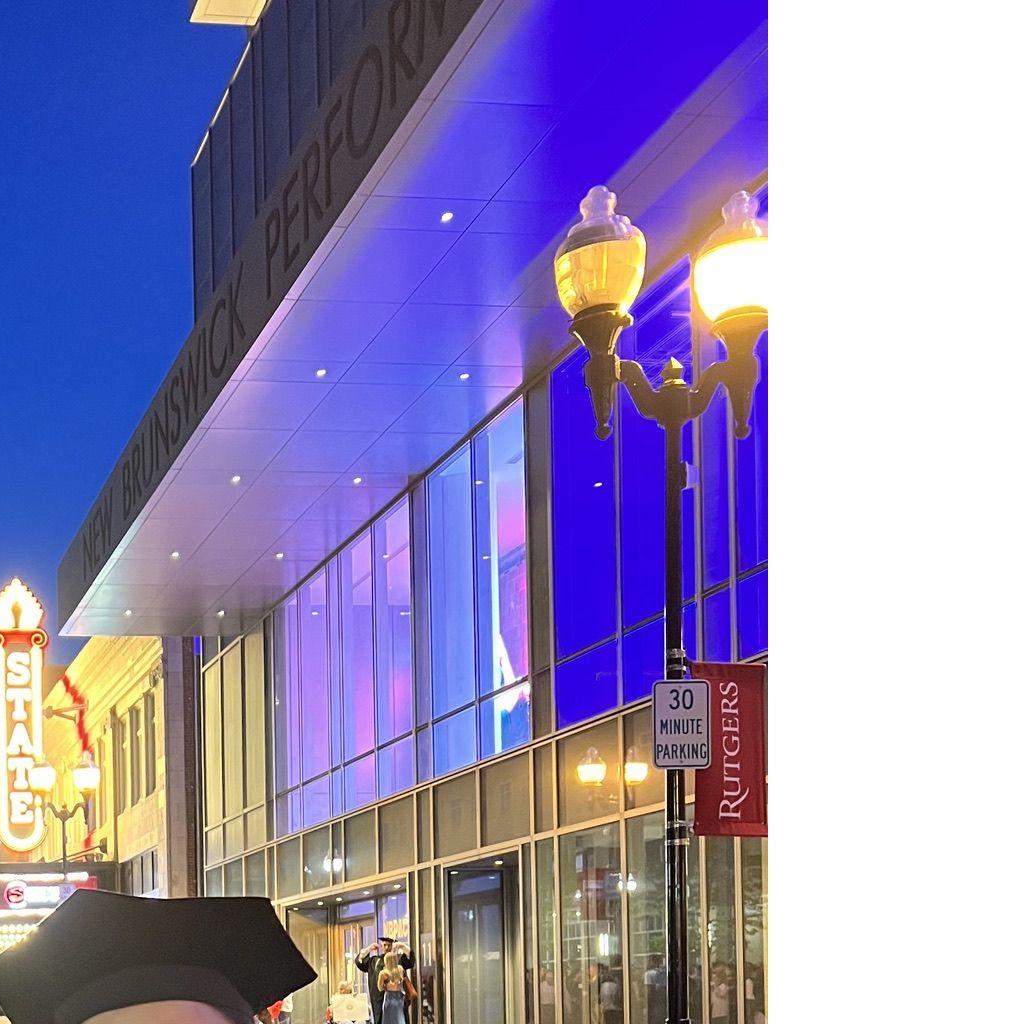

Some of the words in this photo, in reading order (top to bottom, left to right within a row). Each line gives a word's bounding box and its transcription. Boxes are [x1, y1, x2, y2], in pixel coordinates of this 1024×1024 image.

[82, 487, 114, 581] NEW
[122, 261, 246, 521] BRUNSWICK
[669, 689, 694, 710] 30
[6, 651, 35, 824] STATE
[660, 718, 703, 735] MINUTE
[657, 743, 707, 760] PARKING
[718, 681, 750, 820] RUTGERS
[422, 942, 432, 967] 11
